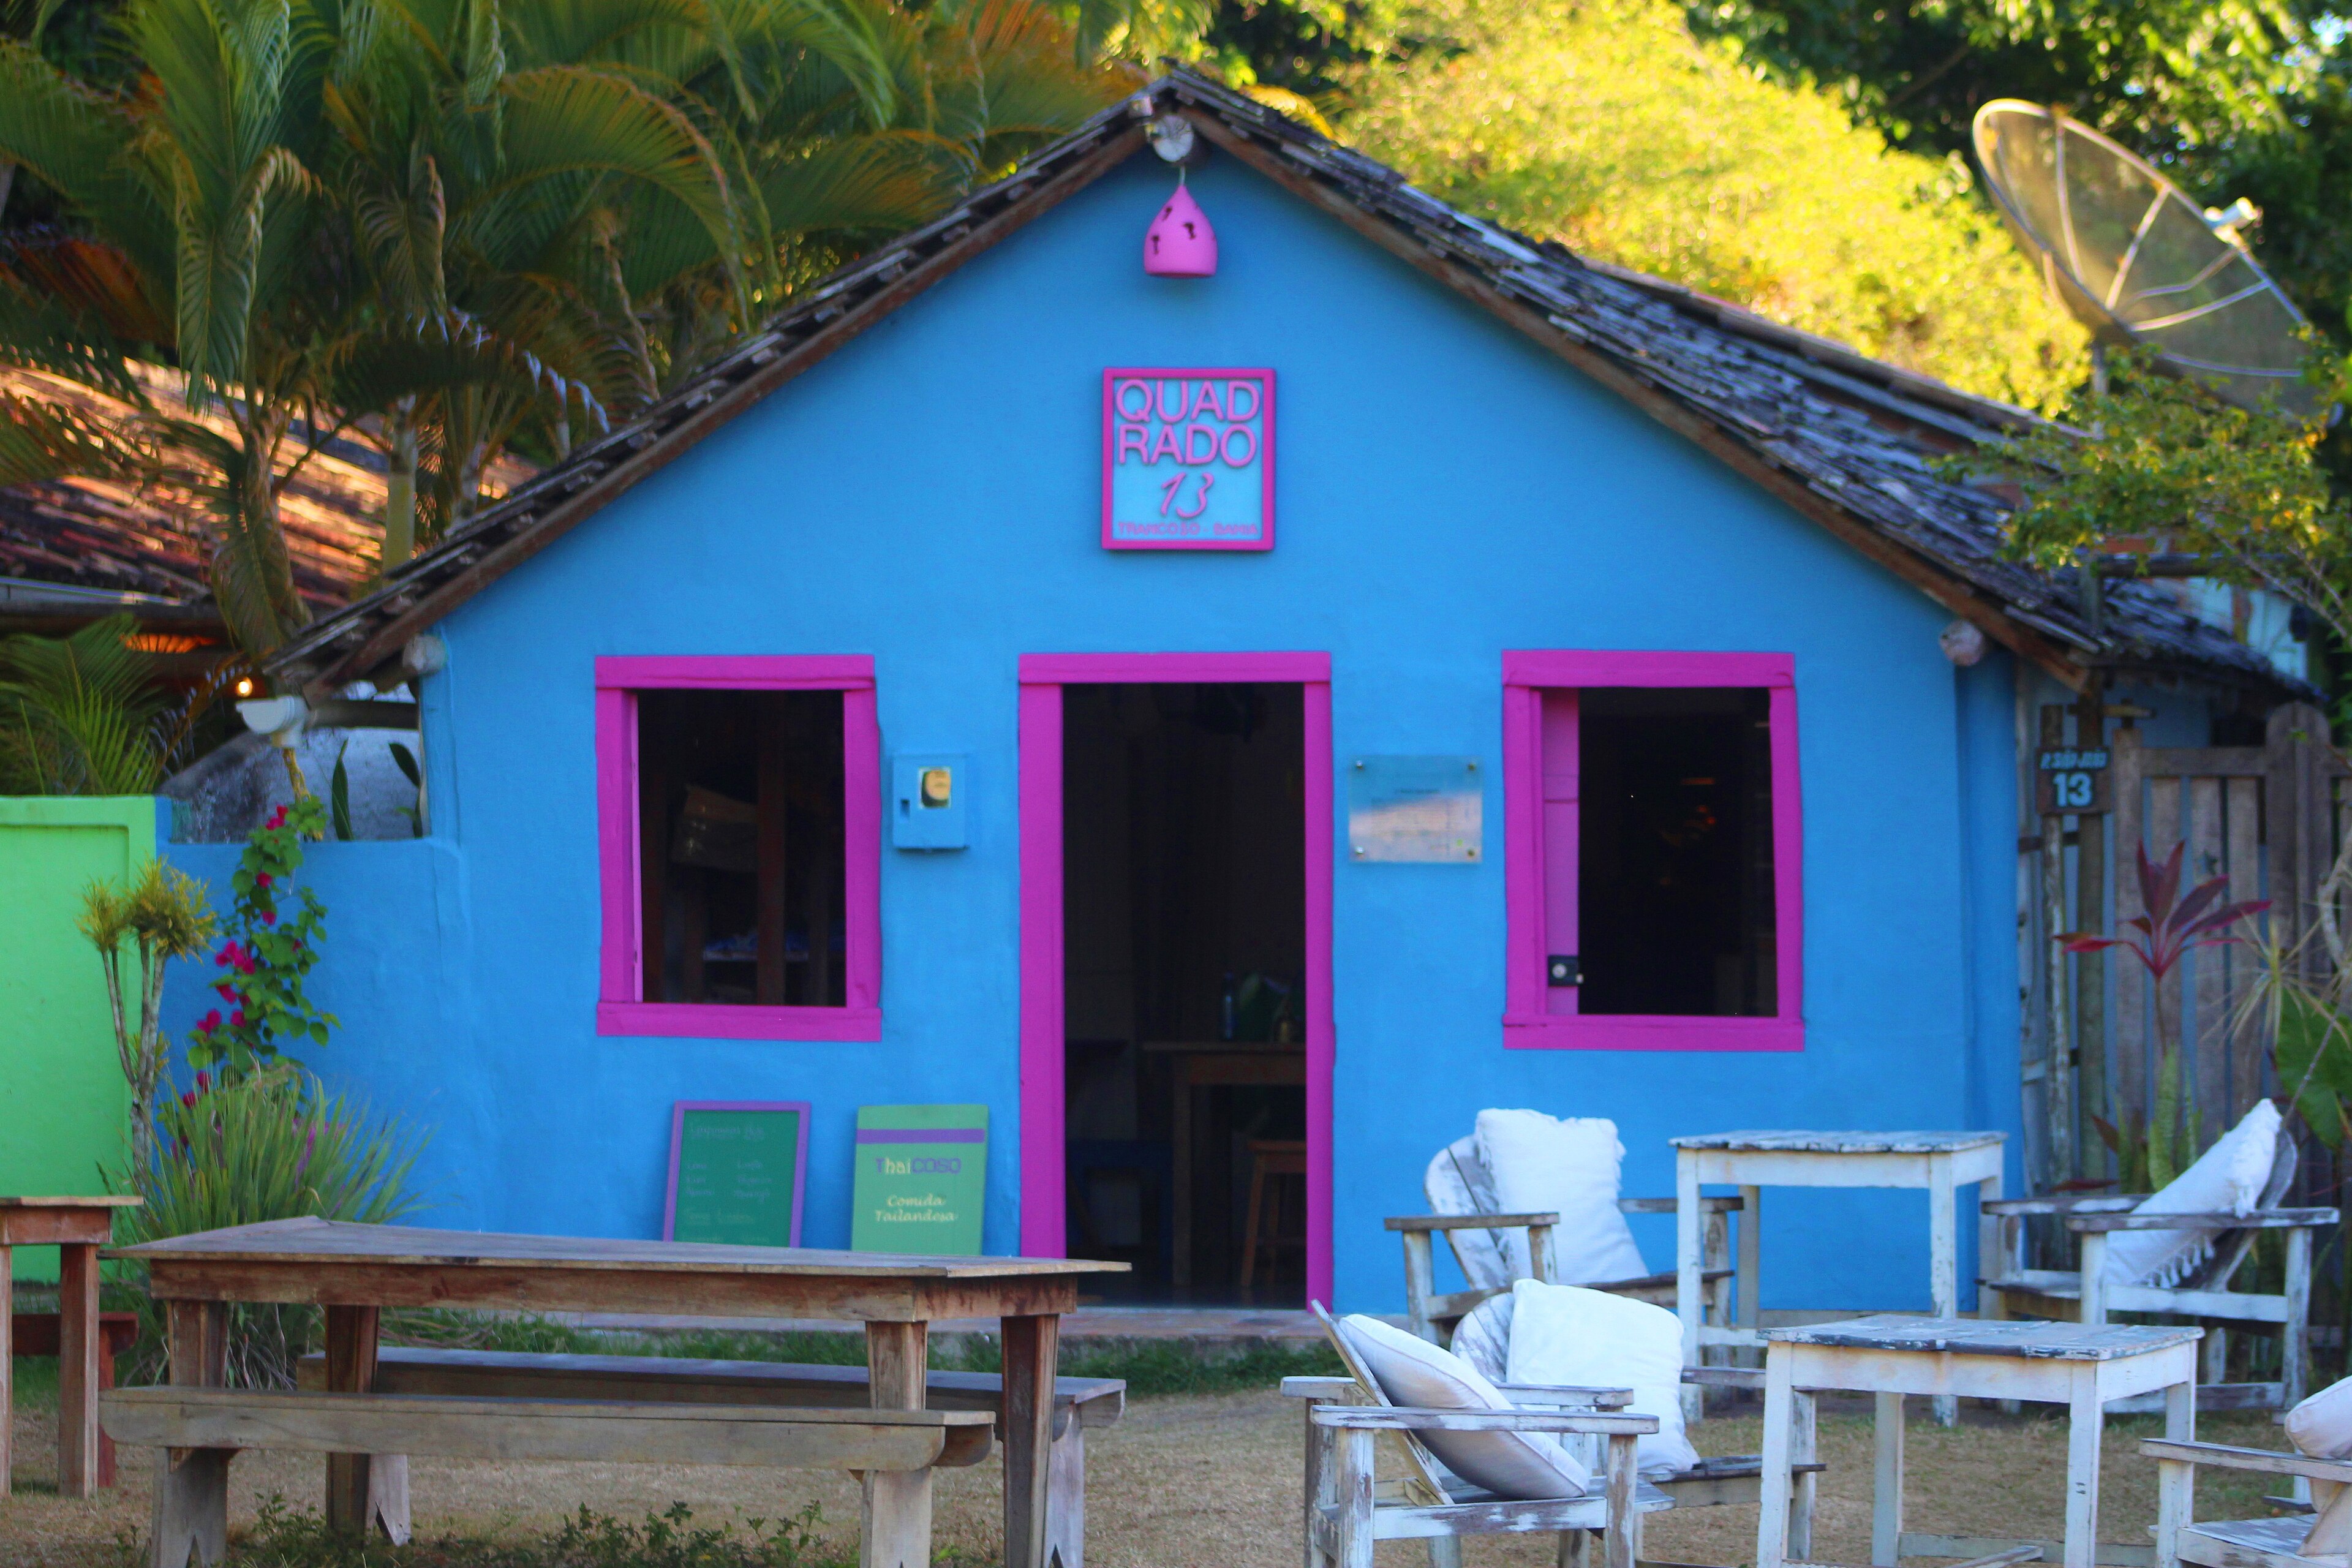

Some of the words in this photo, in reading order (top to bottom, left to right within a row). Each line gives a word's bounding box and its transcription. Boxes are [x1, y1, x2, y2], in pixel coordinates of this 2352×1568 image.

[1116, 379, 1260, 423] QUAD
[1118, 424, 1257, 467] RADO
[1161, 472, 1214, 518] 13
[2053, 772, 2093, 807] 13
[876, 1209, 958, 1222] Tailandesa
[887, 1194, 946, 1207] Comida
